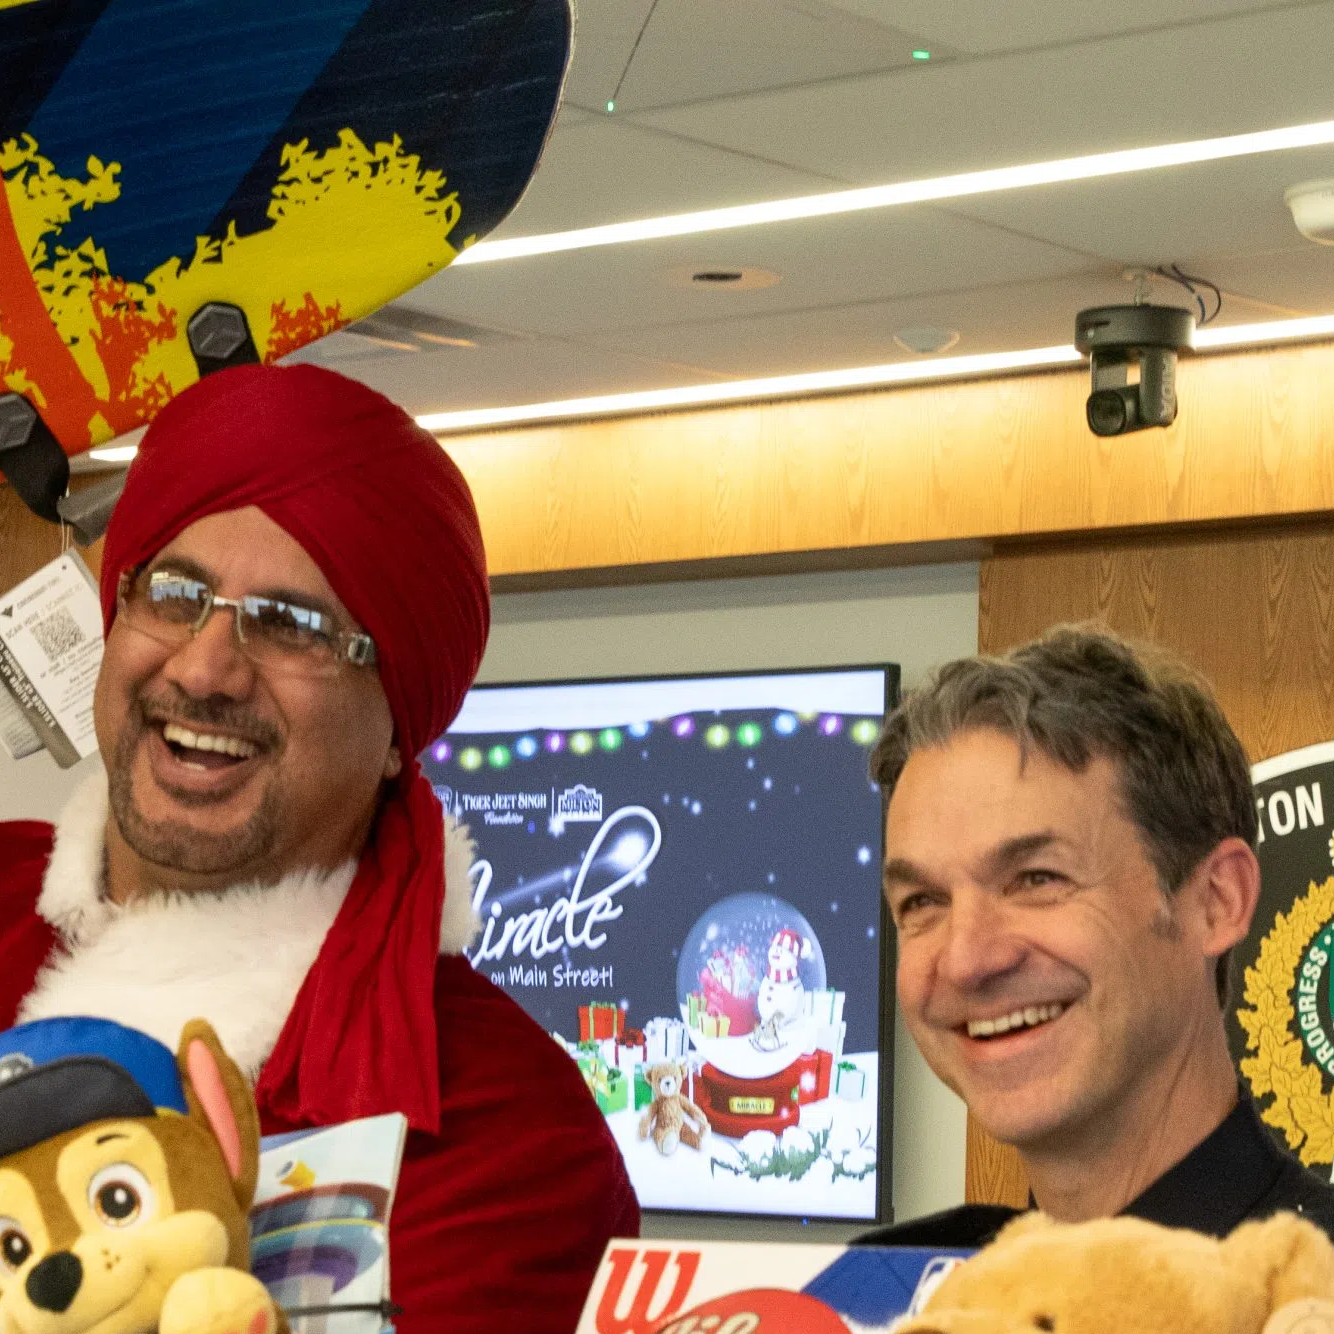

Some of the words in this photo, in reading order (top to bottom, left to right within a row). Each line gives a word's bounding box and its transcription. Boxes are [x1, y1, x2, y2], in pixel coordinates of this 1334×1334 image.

[463, 793, 491, 811] TIGER
[492, 792, 515, 810] JEET
[518, 791, 547, 809] SINGH
[561, 799, 599, 812] MILTON
[492, 971, 505, 986] on
[510, 966, 547, 987] Main
[554, 965, 613, 988] Street!
